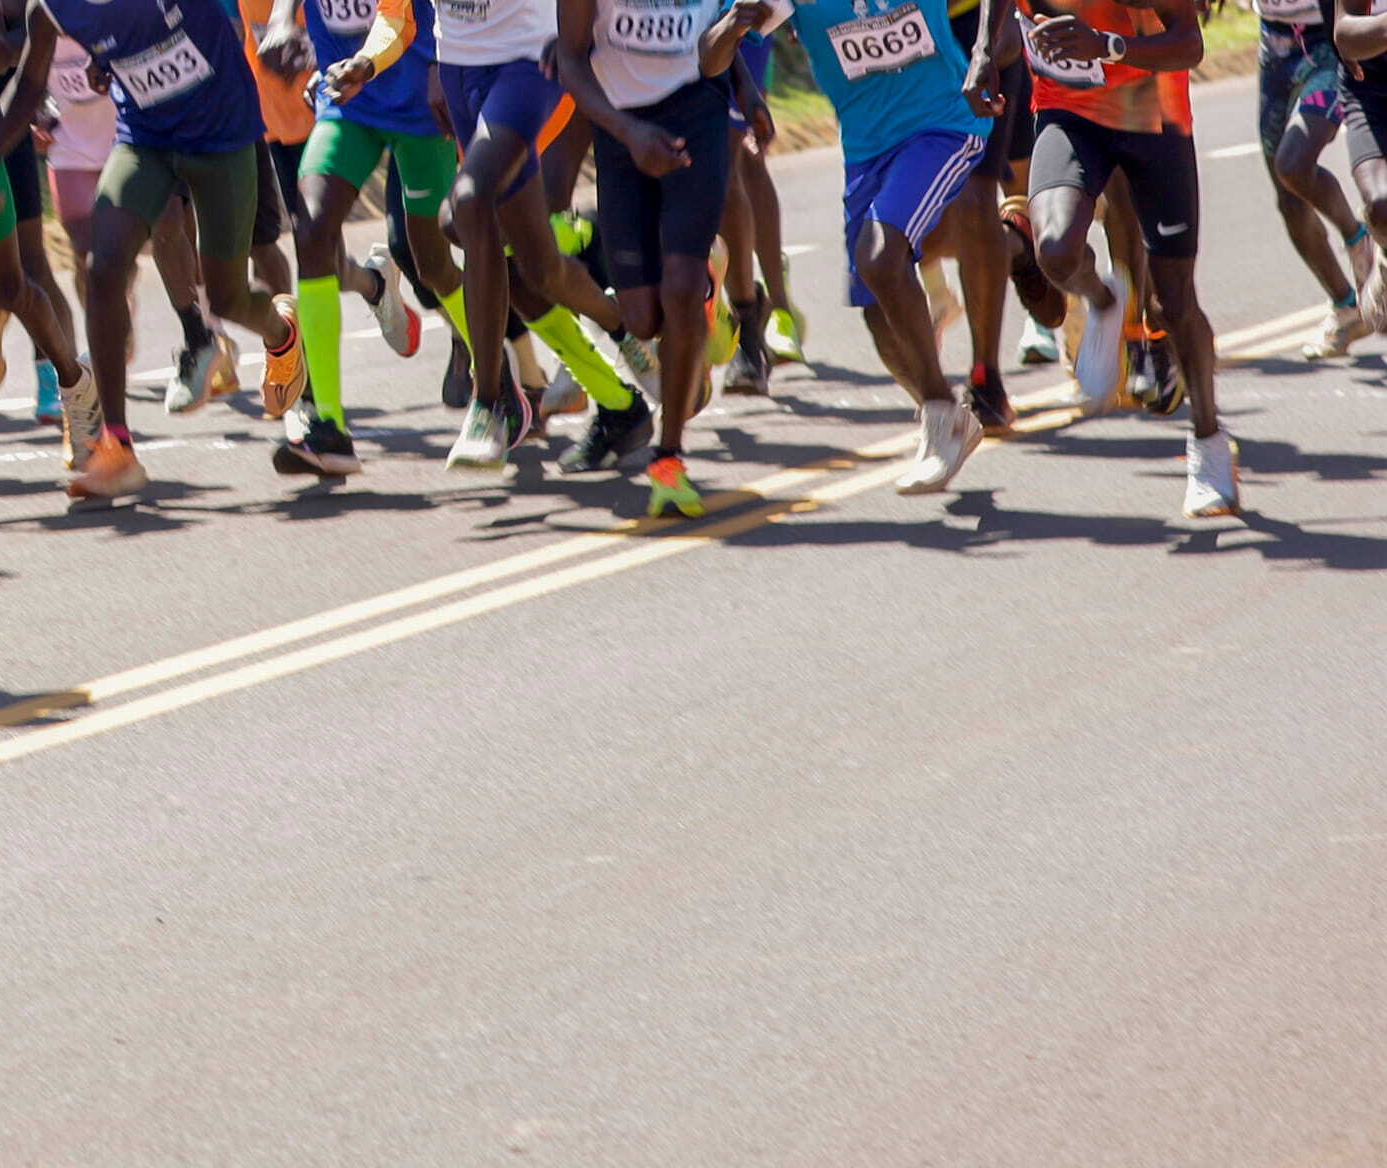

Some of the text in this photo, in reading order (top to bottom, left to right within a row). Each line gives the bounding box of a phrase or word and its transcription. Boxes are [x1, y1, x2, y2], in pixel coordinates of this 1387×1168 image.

[615, 14, 693, 41] 0880
[841, 20, 923, 63] 0669
[128, 48, 197, 94] 0493
